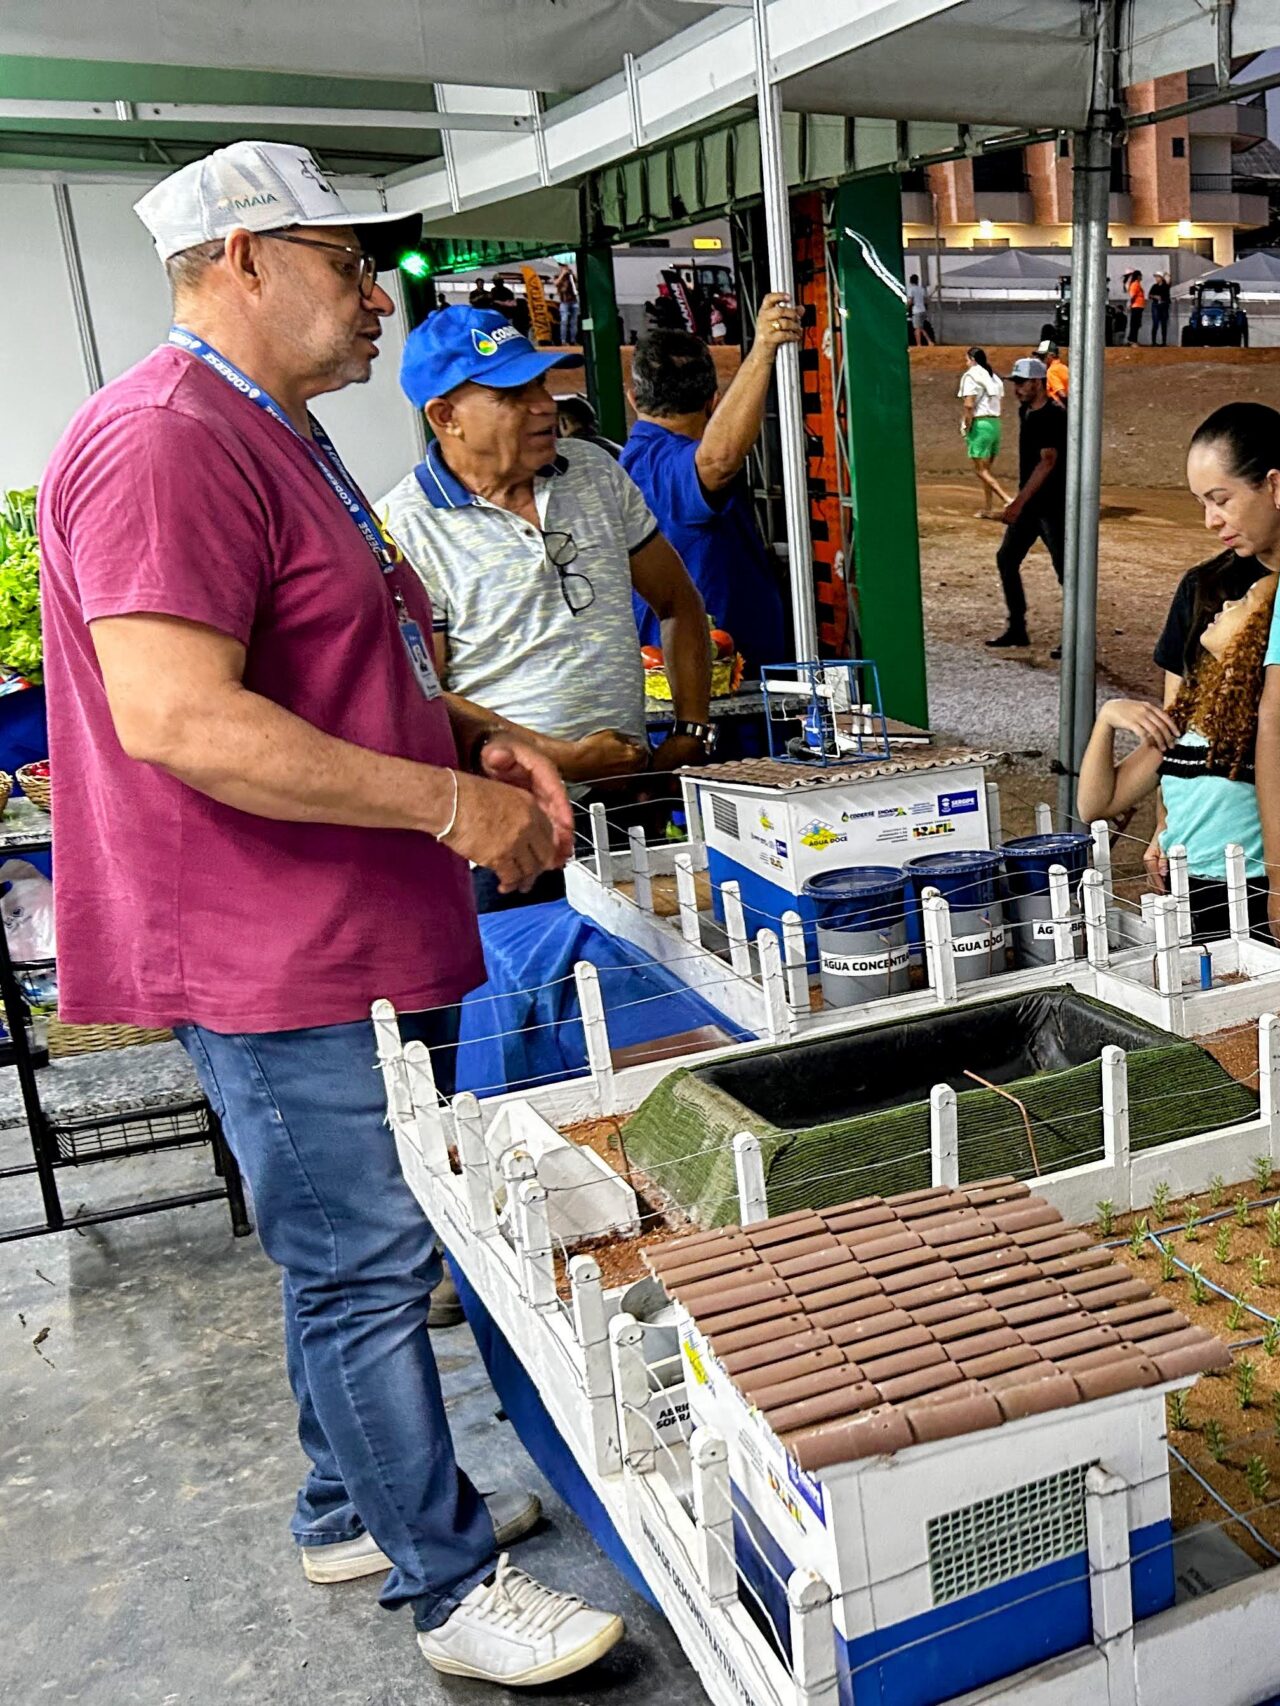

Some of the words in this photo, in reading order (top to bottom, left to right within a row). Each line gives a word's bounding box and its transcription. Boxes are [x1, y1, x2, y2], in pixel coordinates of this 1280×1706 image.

[235, 193, 278, 209] MAIA
[202, 352, 251, 393] CODERSE
[358, 520, 382, 553] DERSE
[1037, 924, 1054, 935] ÁG
